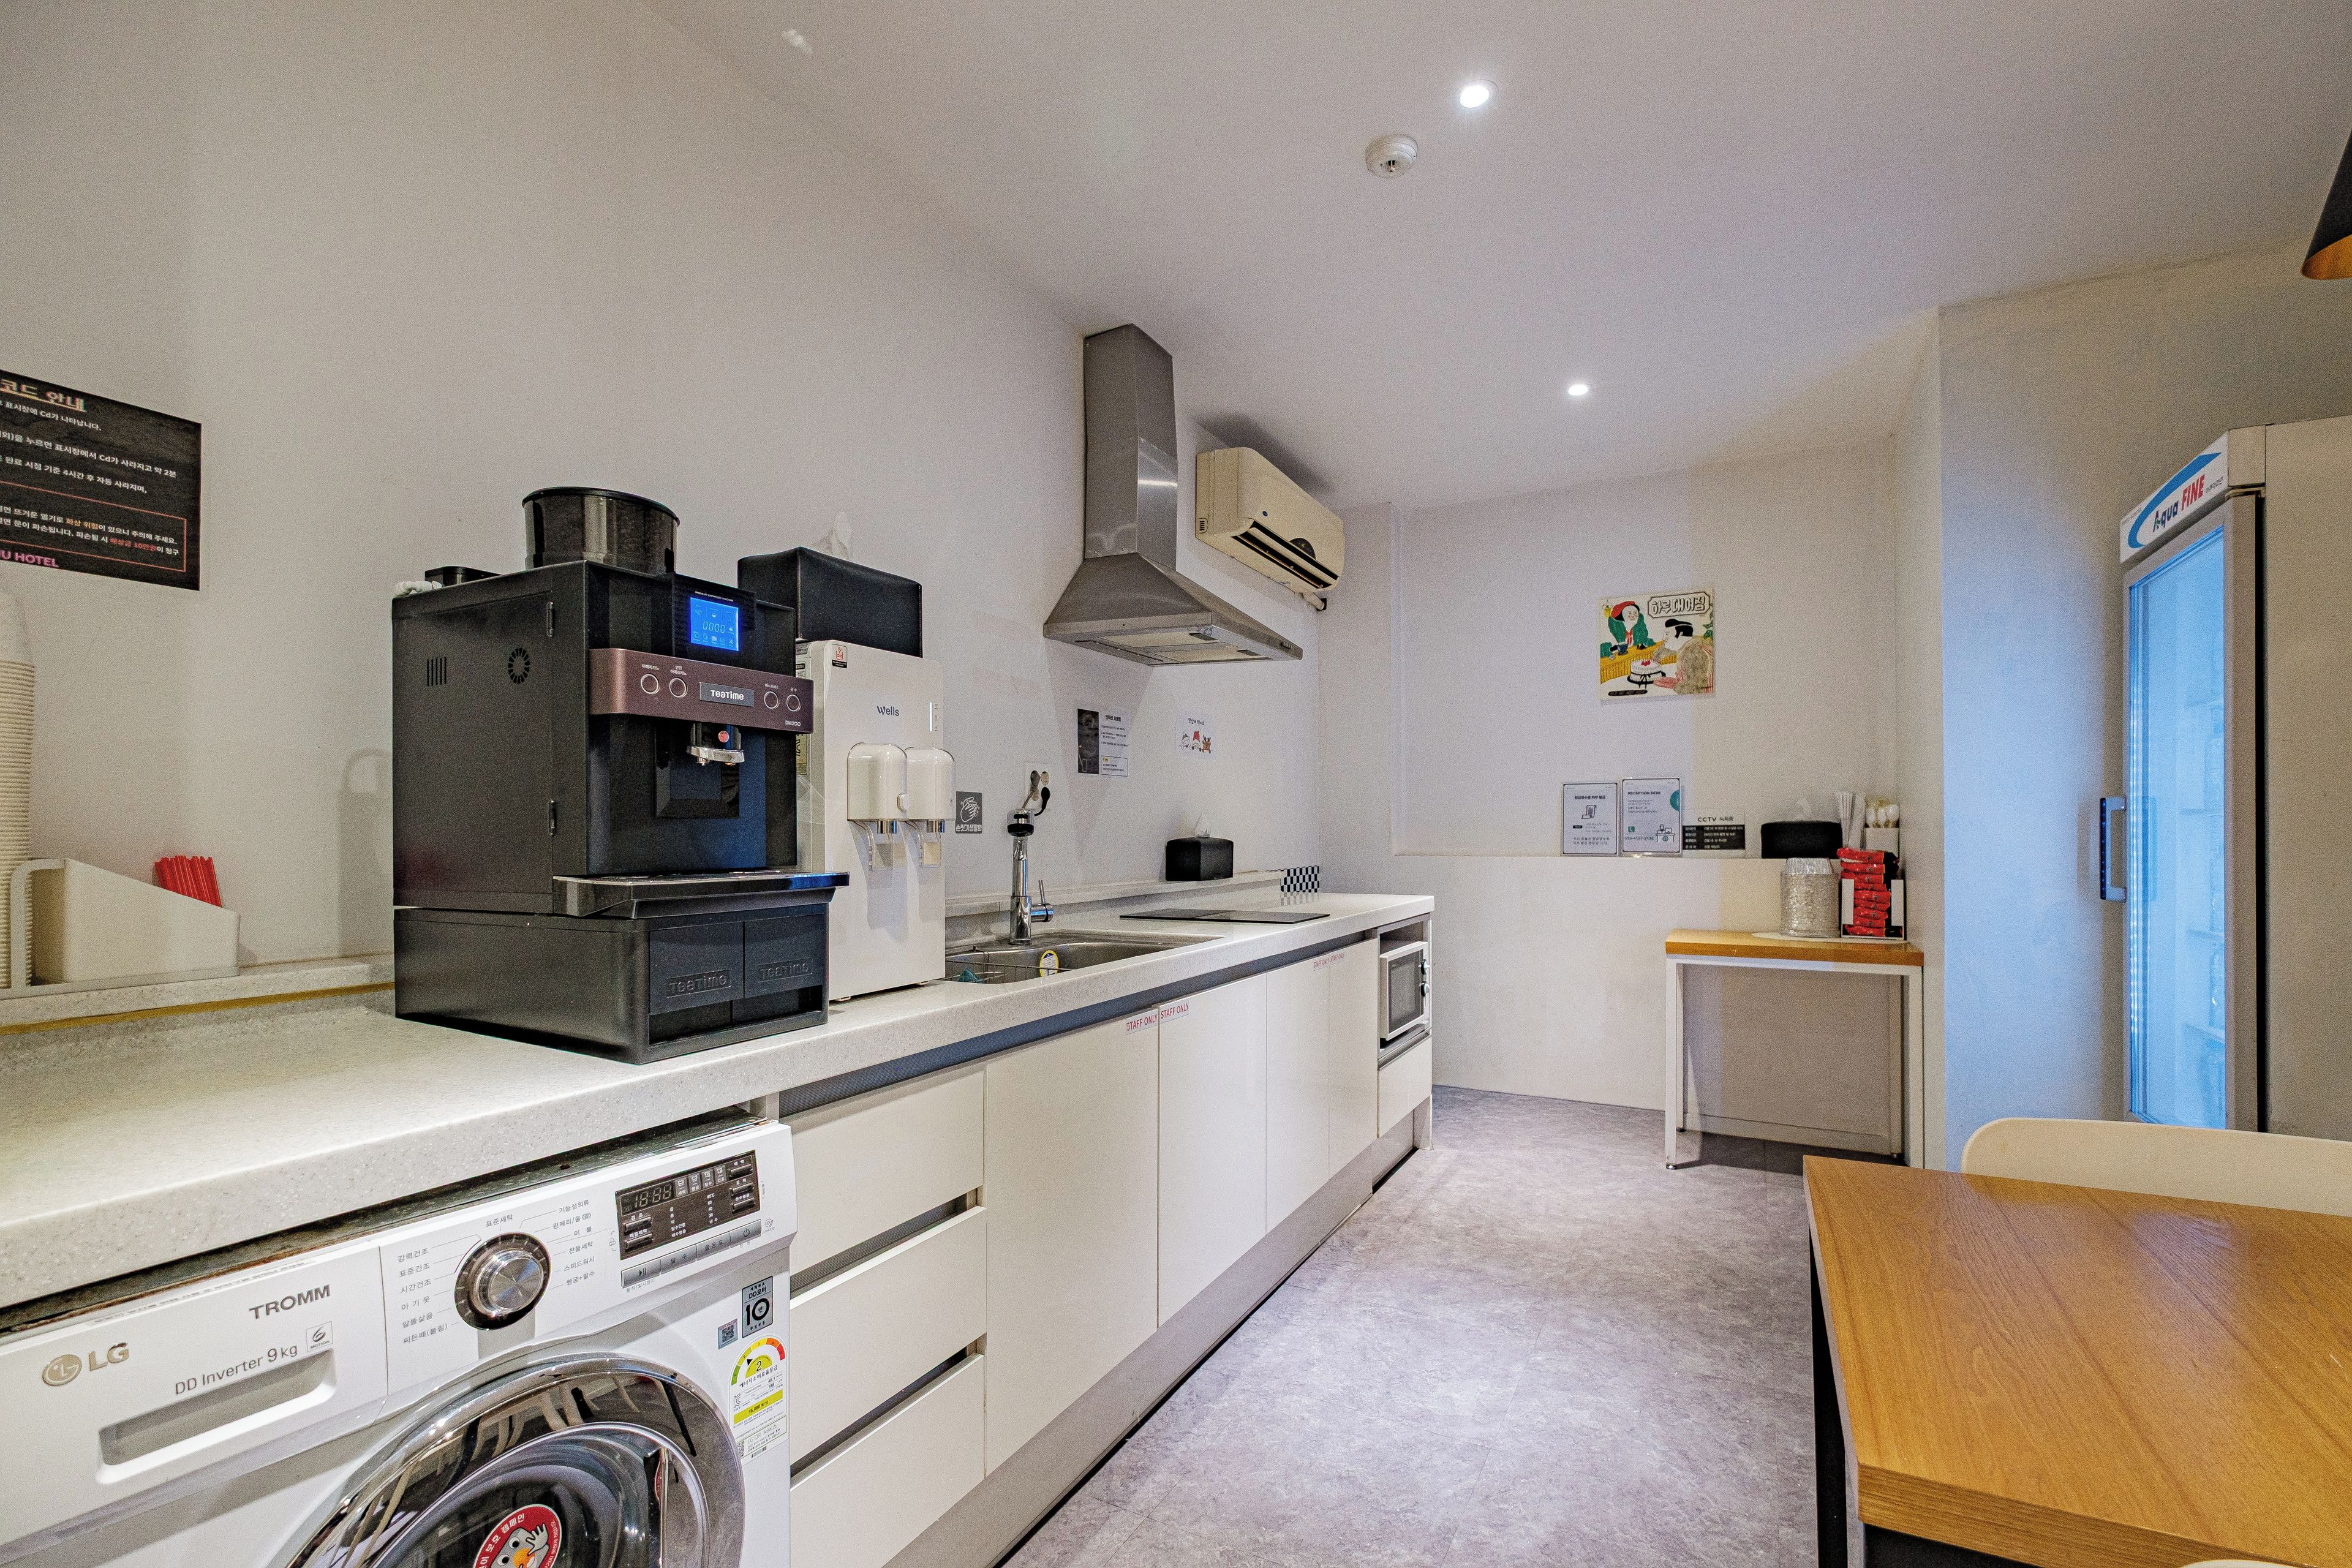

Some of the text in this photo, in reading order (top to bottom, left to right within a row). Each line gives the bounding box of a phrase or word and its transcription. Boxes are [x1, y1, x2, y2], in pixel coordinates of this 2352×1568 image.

[1, 379, 86, 412] 코드 안내
[5, 402, 101, 431] 표시창에 Cd가 나타납니다.
[26, 437, 52, 449] 누르면
[55, 444, 97, 459] 표시창에서
[99, 454, 119, 464] Cd가
[121, 459, 153, 472] 사라지고
[5, 456, 22, 466] 완료
[24, 462, 42, 470] 시점
[63, 470, 84, 480] 4시간
[97, 477, 113, 486] 자동
[115, 480, 147, 494] 사라지며,
[2153, 500, 2179, 532] Aqua
[2182, 474, 2205, 511] FINE
[13, 508, 39, 519] 뜨거운
[40, 513, 64, 523] 열기로
[66, 518, 81, 527] 화상
[108, 526, 129, 535] 있으니
[132, 530, 153, 540] 주의해
[154, 535, 177, 545] 주세요.
[13, 520, 29, 529] 문이
[32, 524, 74, 537] 파손됩니다.
[76, 531, 99, 541] 파손될
[165, 546, 179, 556] 청구
[14, 552, 59, 568] HOTEL
[710, 690, 744, 701] TeaTime
[876, 706, 899, 717] Wells
[1161, 1003, 1188, 1019] STAFF ONLY
[1126, 1014, 1158, 1031] STAFF ONLY
[559, 1199, 590, 1213] 기능성의류
[486, 1213, 513, 1227] 표준세탁
[398, 1248, 429, 1262] 강력건조
[569, 1241, 593, 1254] 찬물세탁
[399, 1263, 431, 1278] 표준건조
[564, 1256, 595, 1272] 스피드워시
[401, 1278, 431, 1294] 시간건조
[567, 1270, 595, 1286] 헹굼+탈수
[748, 1286, 767, 1299] DD모터
[249, 1284, 330, 1319] TROMM
[746, 1298, 770, 1325] 10
[402, 1312, 434, 1329] 알뜰삶음
[403, 1323, 448, 1344] 찌든때(불림)
[311, 1340, 330, 1349] MOTION
[88, 1342, 129, 1371] LG
[756, 1360, 762, 1372] 2
[175, 1378, 197, 1395] DD
[202, 1356, 264, 1386] Inverter
[739, 1365, 778, 1388] 에너지소비효율등급
[764, 1424, 777, 1434] 서비스
[486, 1534, 501, 1553] 보호
[501, 1513, 524, 1534] 캠페인
